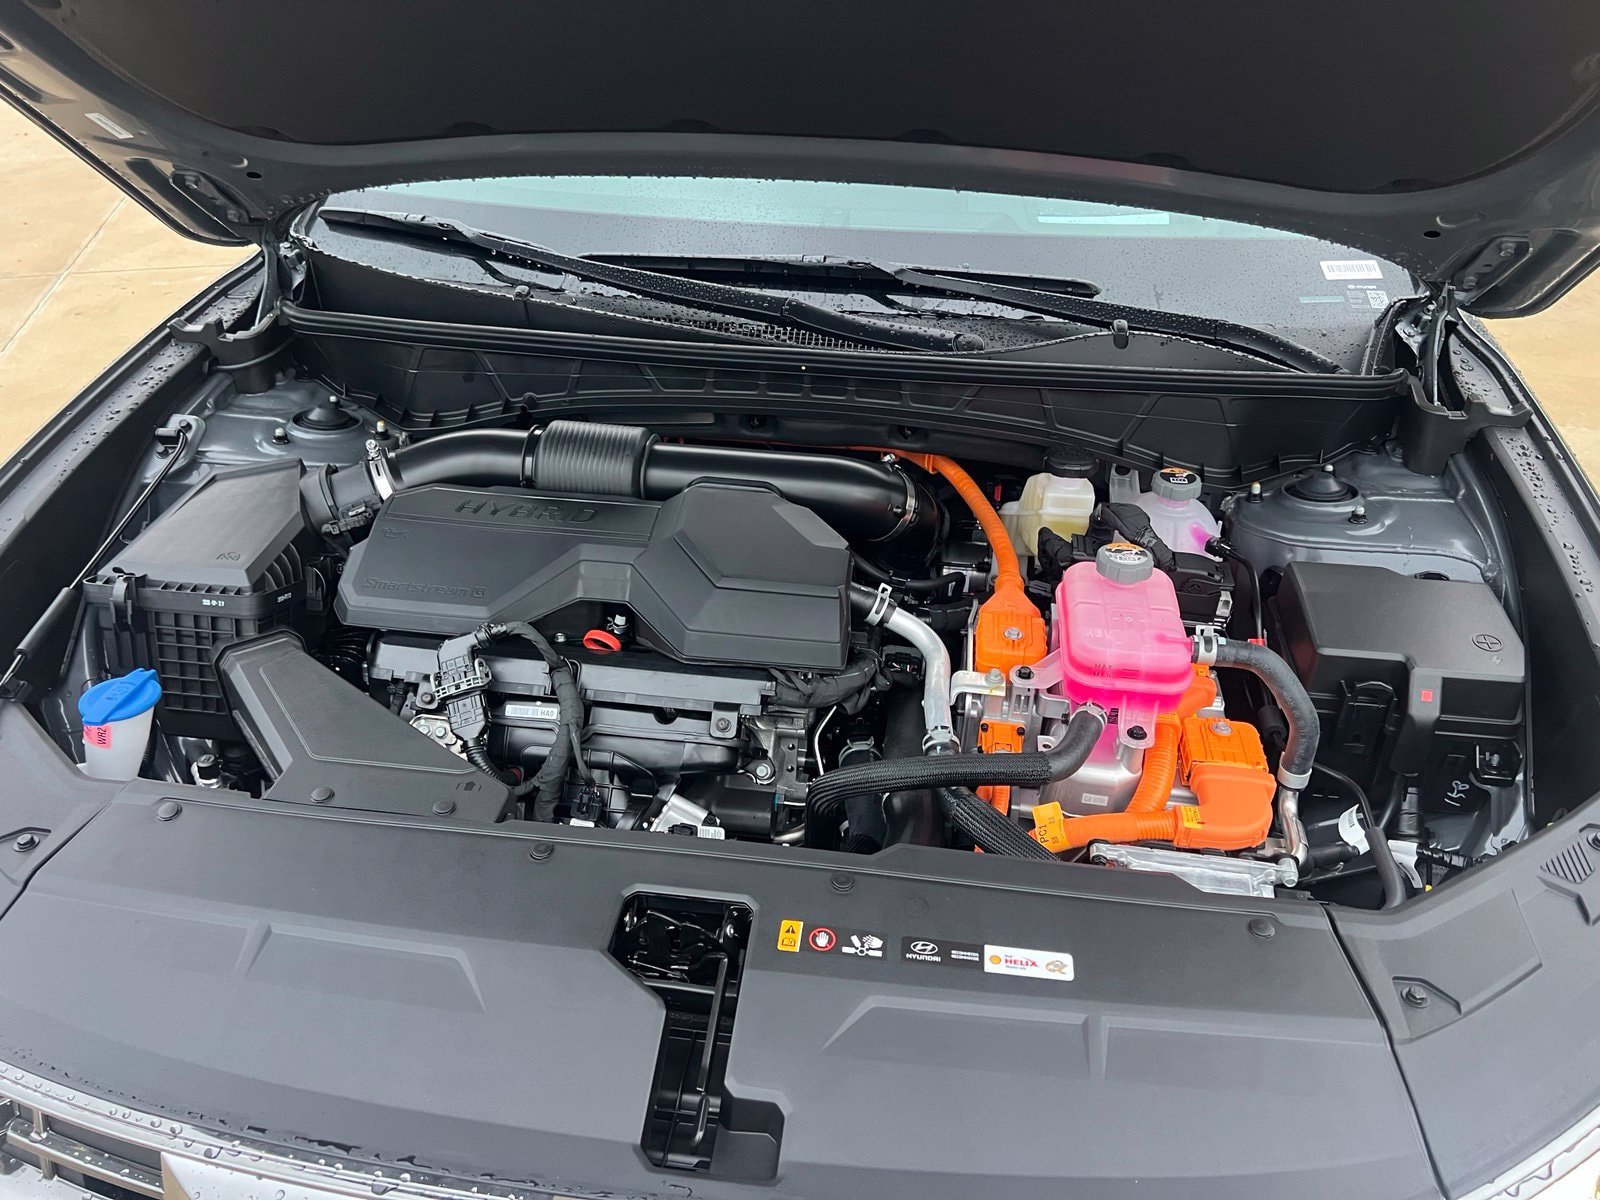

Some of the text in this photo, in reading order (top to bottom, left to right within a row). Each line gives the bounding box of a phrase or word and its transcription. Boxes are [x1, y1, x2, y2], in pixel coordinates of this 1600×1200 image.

[454, 499, 598, 524] HYBRID
[362, 577, 467, 598] Smartstream
[905, 953, 941, 962] HYUNDAI
[1004, 957, 1039, 968] HELIX
